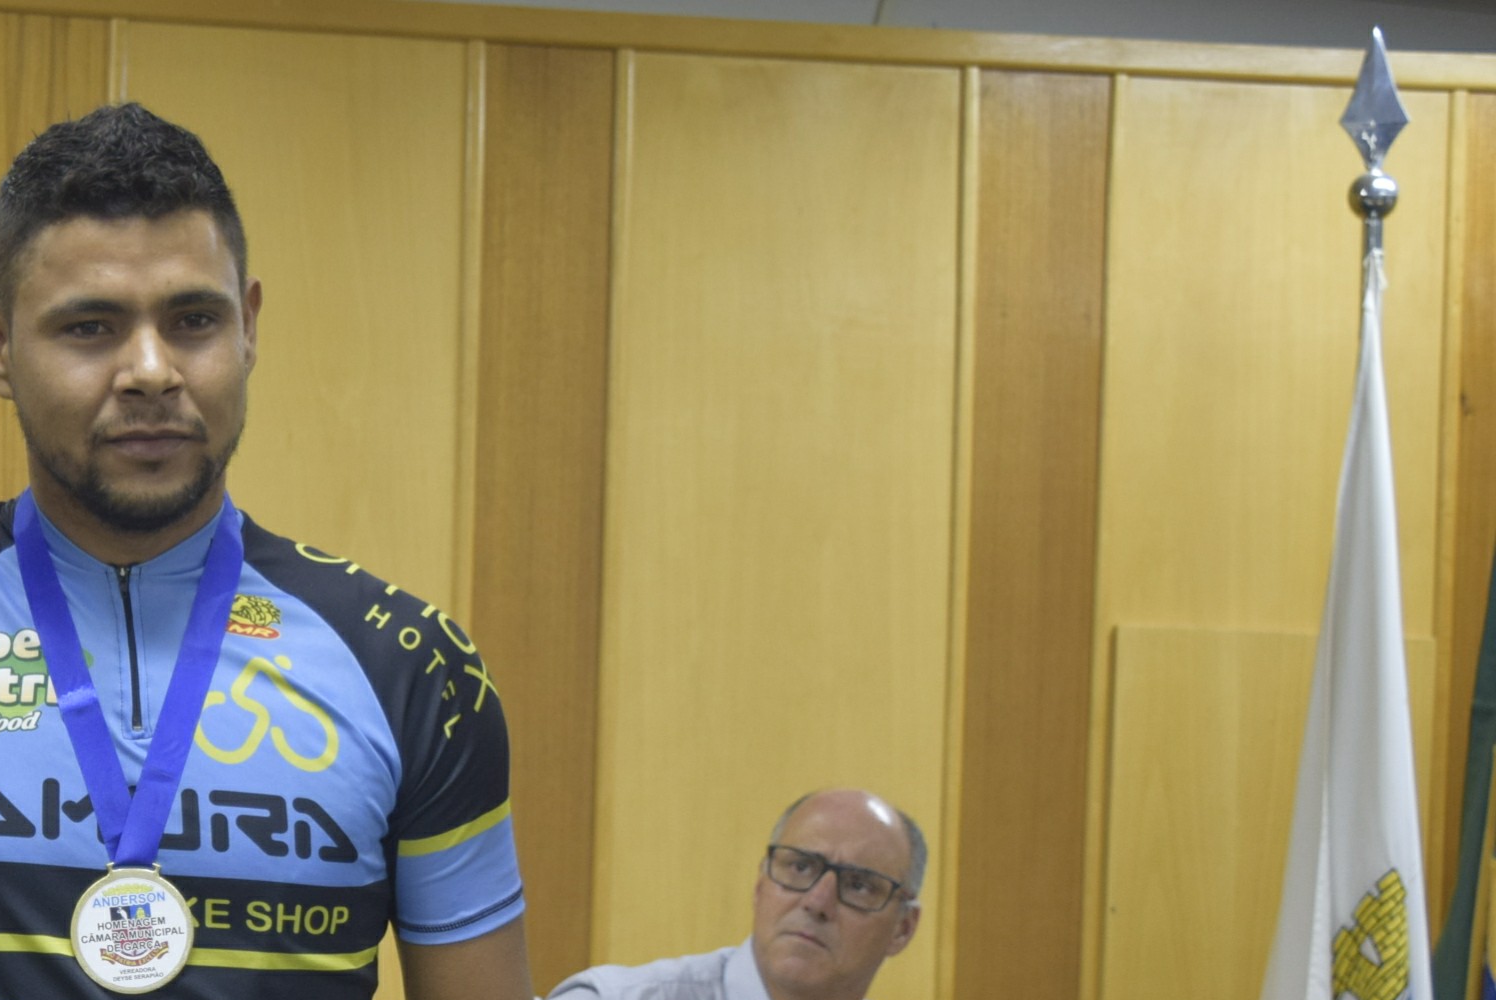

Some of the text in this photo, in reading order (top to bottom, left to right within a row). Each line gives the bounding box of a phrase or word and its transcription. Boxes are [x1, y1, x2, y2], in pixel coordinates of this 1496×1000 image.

[228, 624, 274, 637] MR
[92, 892, 166, 908] ANDERSON
[97, 916, 166, 931] HOMENAGEM
[245, 901, 350, 935] SHOP
[81, 927, 184, 944] CÂMARA MUNICIPAL
[106, 940, 161, 953] DE GARÇA
